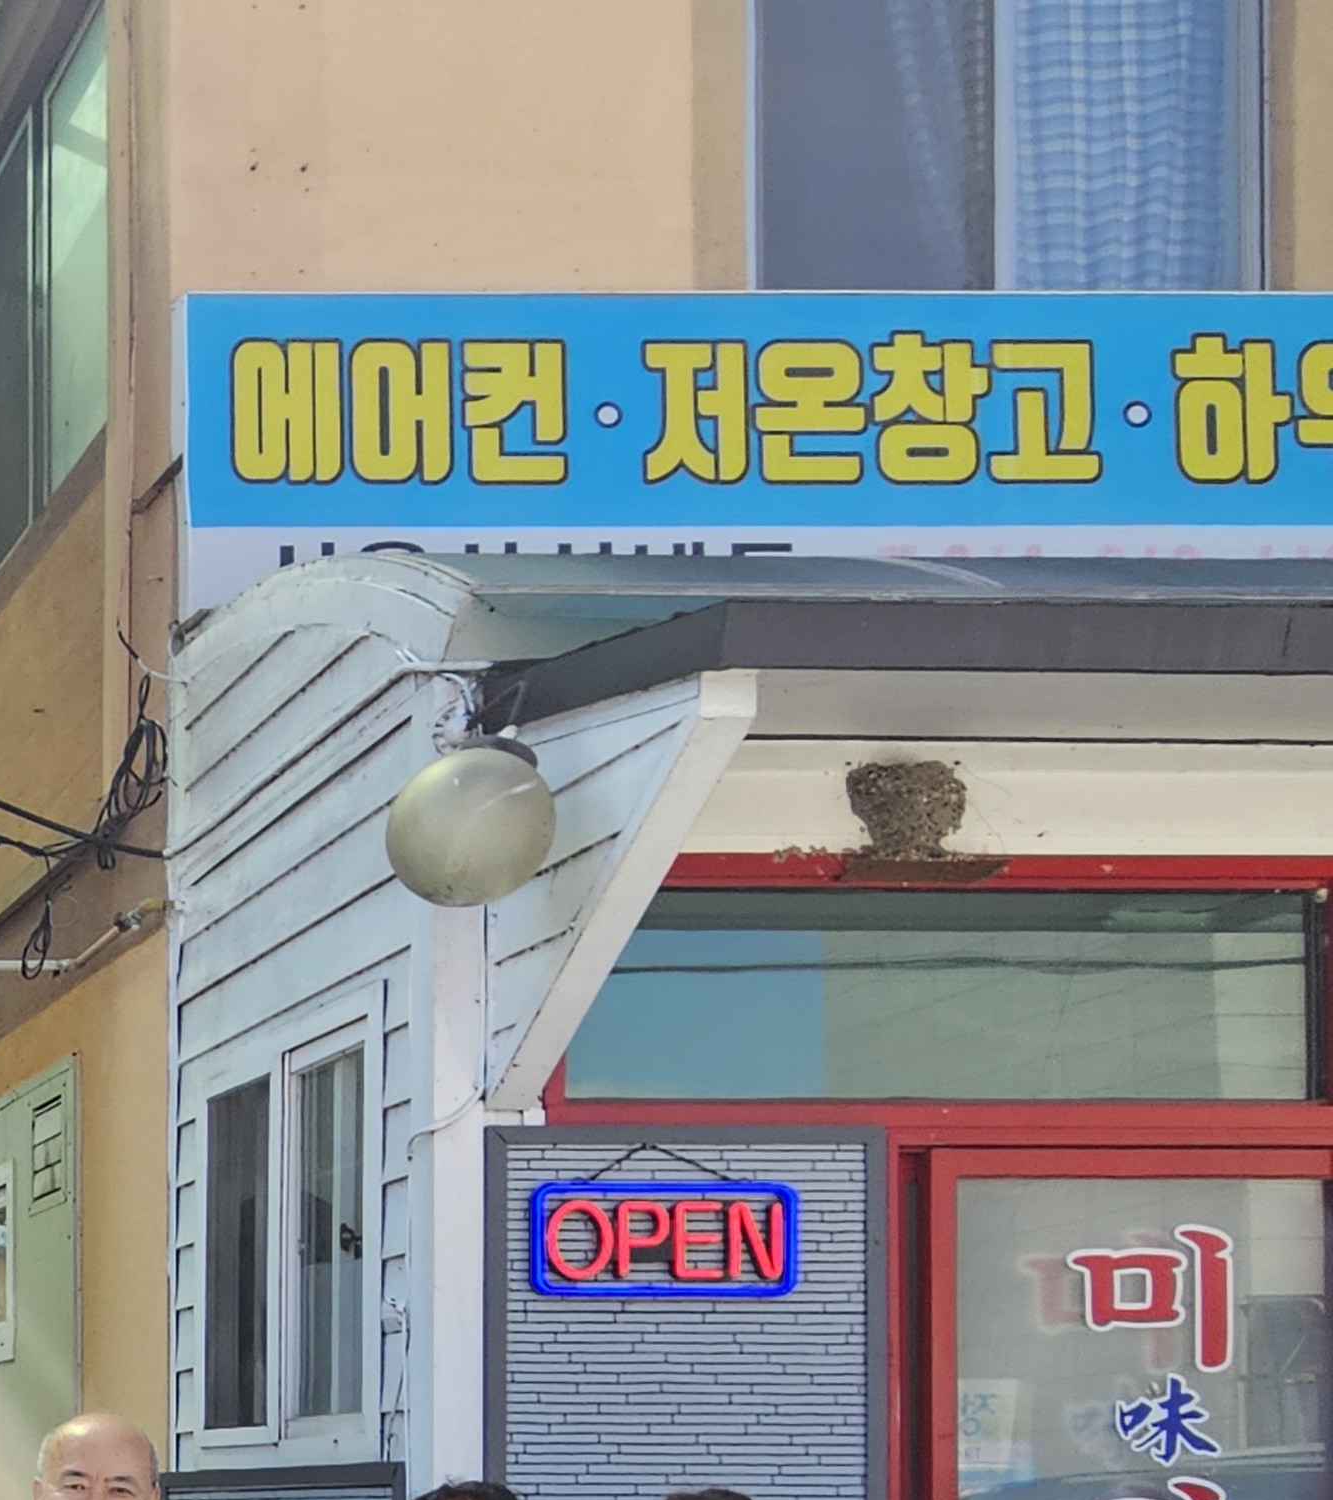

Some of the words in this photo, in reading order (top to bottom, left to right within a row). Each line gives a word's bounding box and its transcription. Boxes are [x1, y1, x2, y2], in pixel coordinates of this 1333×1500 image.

[230, 338, 569, 485] 에어컨
[641, 330, 1102, 485] 저온창고
[545, 1199, 786, 1281] OPEN
